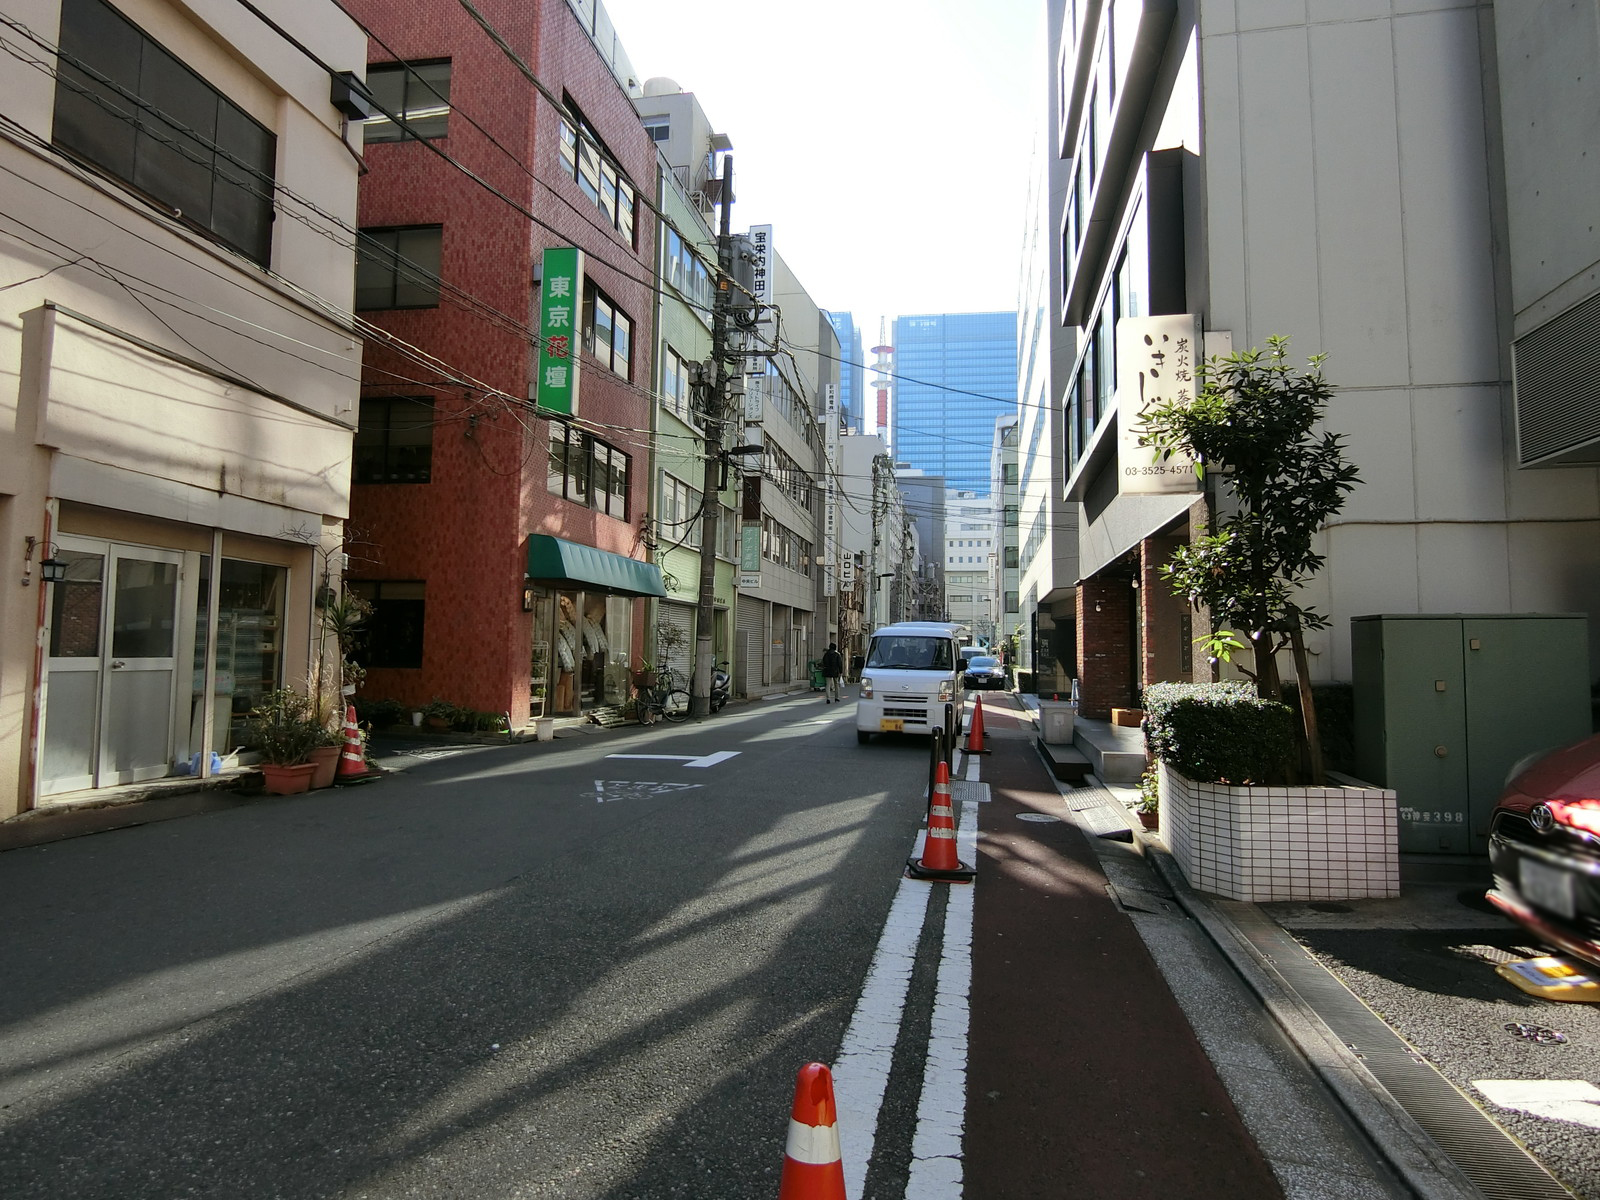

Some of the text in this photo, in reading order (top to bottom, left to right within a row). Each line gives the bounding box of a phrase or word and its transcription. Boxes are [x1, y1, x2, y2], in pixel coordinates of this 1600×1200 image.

[545, 275, 571, 388] 東京花壇
[1174, 337, 1192, 382] 炭火焼
[1125, 466, 1194, 476] 03-3525-4571
